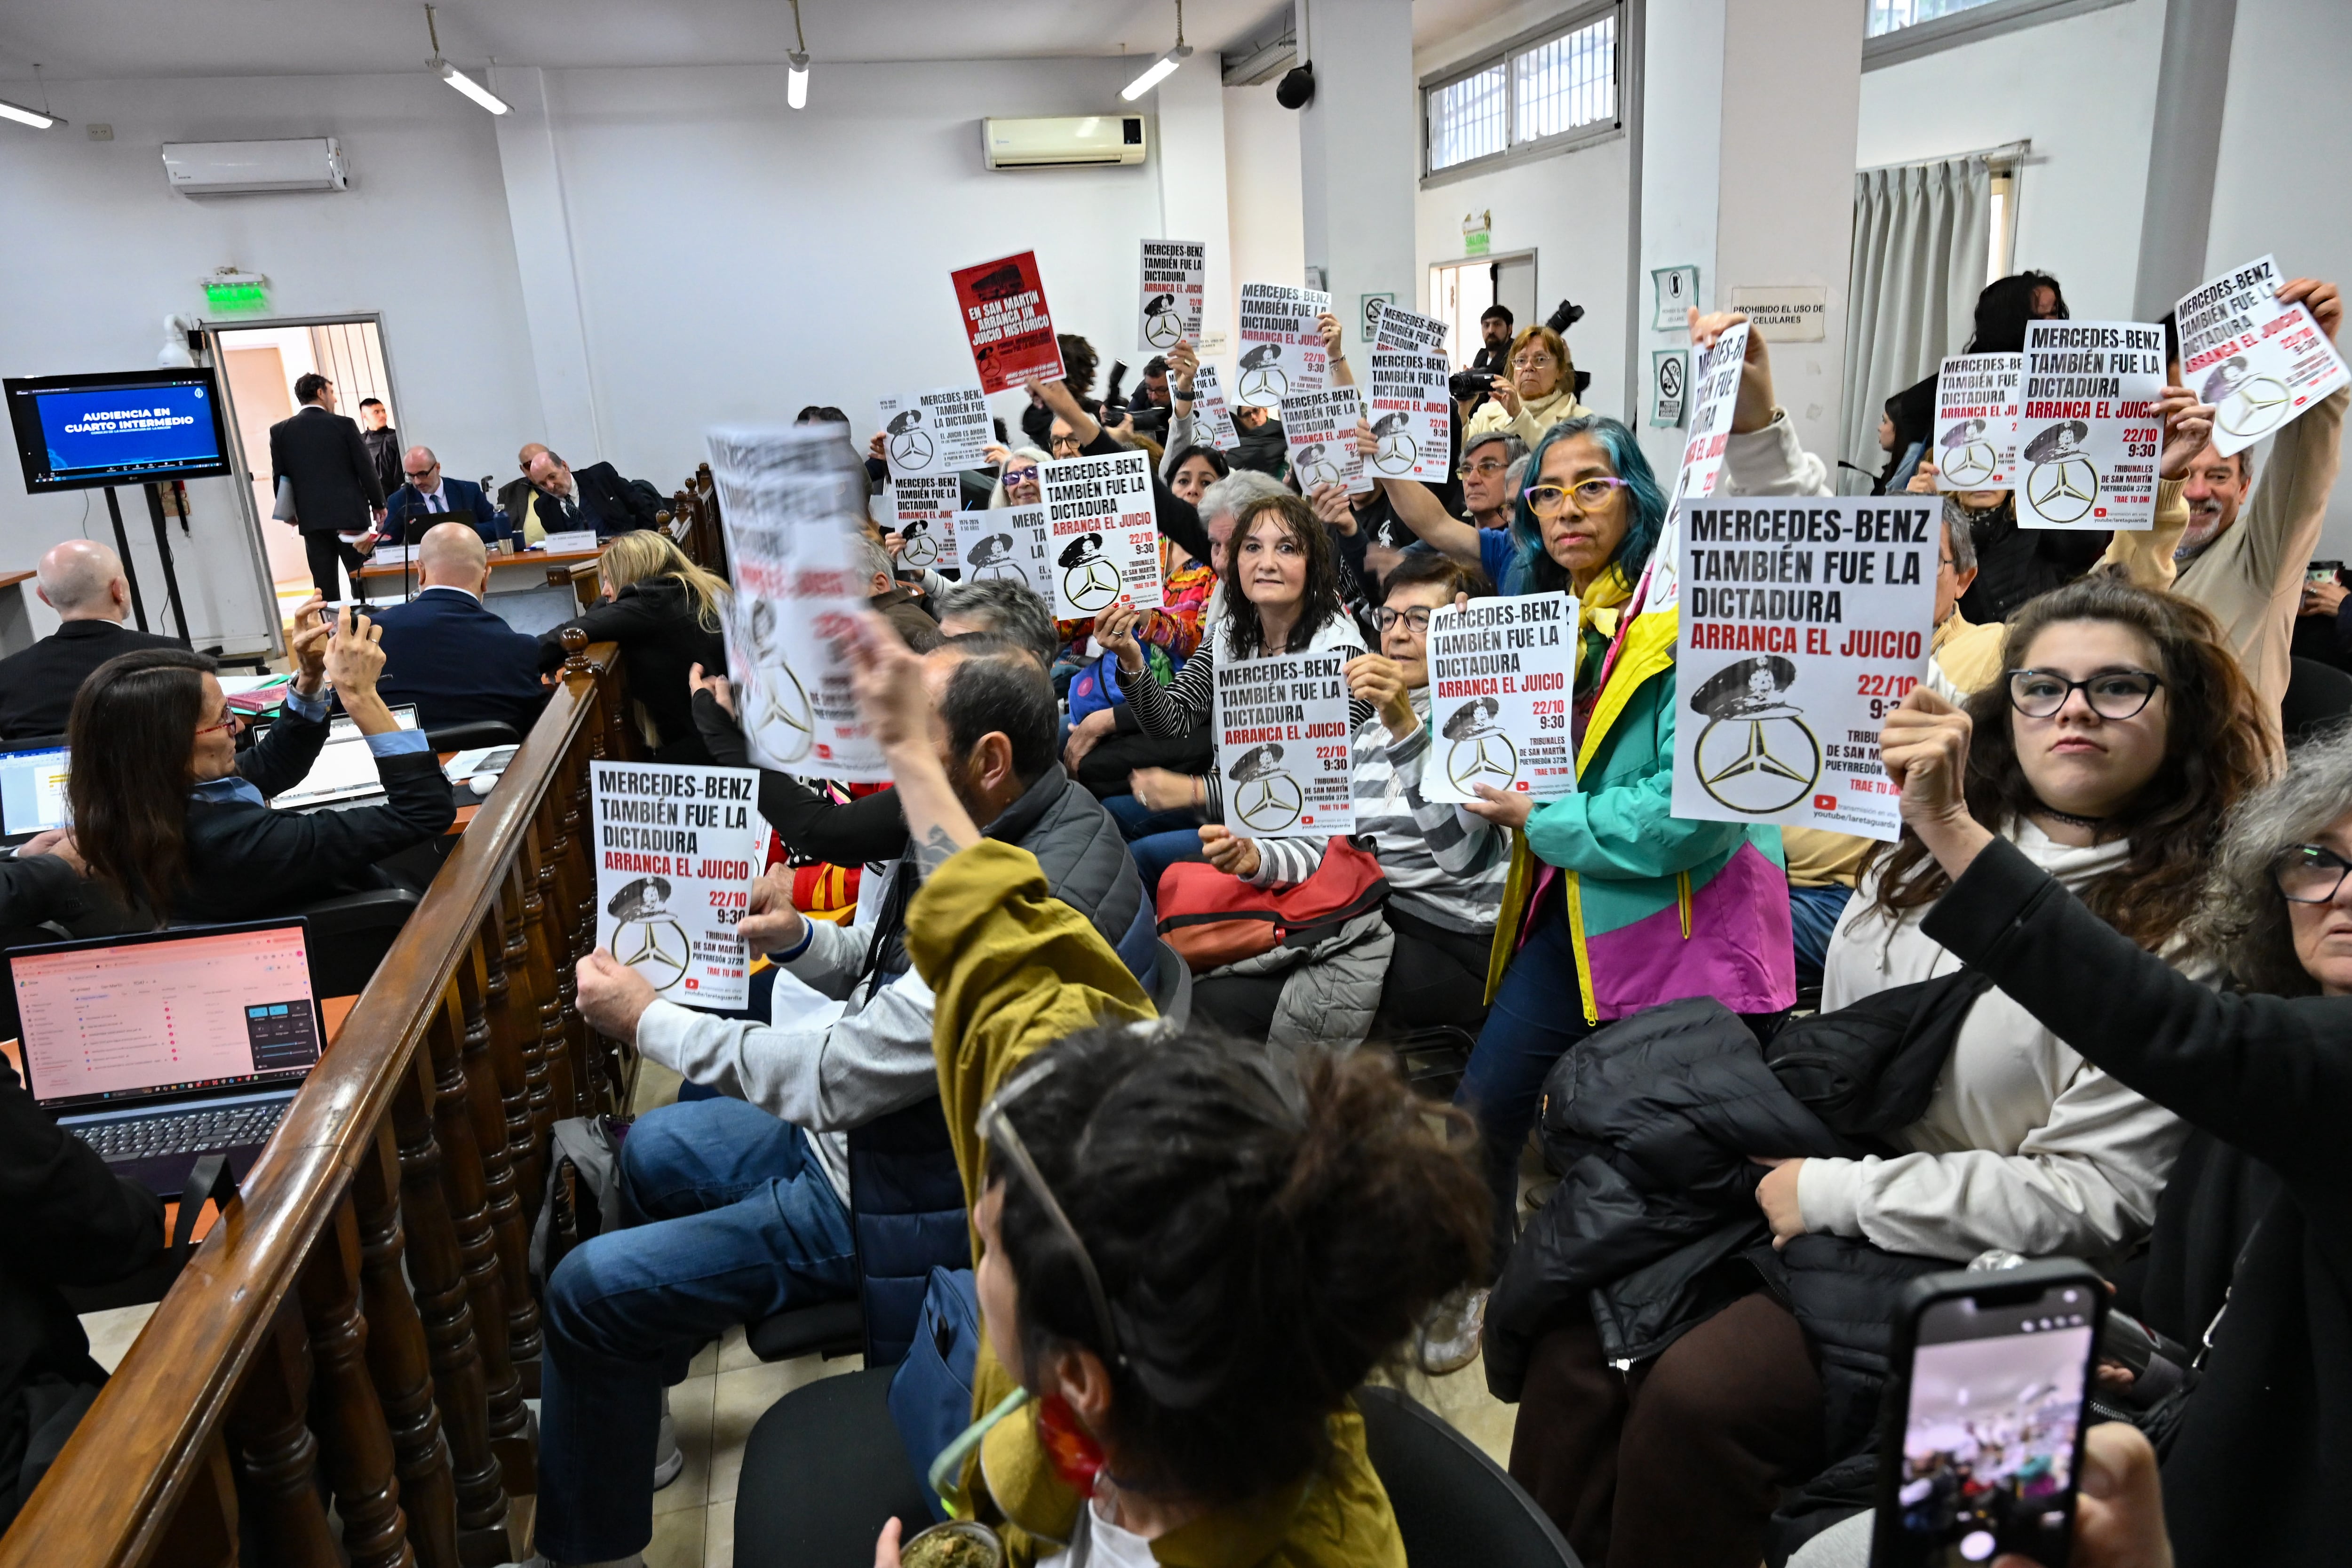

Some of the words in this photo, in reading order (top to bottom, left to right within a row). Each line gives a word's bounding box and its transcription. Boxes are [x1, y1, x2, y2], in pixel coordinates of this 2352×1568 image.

[1144, 244, 1202, 257] MERCEDES-BENZ
[1144, 256, 1177, 270] TAMBIÉN
[1180, 260, 1192, 270] FUE
[1194, 260, 1201, 271] LA
[1145, 271, 1185, 282] DICTADURA
[1144, 283, 1174, 293] ARRANCA
[1177, 284, 1183, 293] EL
[1185, 284, 1202, 294] JUICIO
[1242, 284, 1329, 304] MERCEDES-BENZ
[2179, 262, 2273, 321] MERCEDES-BENZ
[968, 307, 982, 320] EN
[983, 300, 1002, 317] SAN
[1004, 290, 1039, 311] MARTÍN
[1242, 299, 1288, 316] TAMBIÉN
[1292, 304, 1310, 317] FUE
[977, 311, 1020, 332] ARRANCA
[1022, 306, 1035, 319] UN
[1242, 316, 1299, 332] DICTADURA
[1384, 308, 1447, 337] MERCEDES-BENZ
[2181, 302, 2228, 340] TAMBIÉN
[972, 328, 1002, 346] JUICIO
[1242, 330, 1282, 343] ARRANCA
[1286, 334, 1295, 344] EL
[1382, 320, 1414, 341] TAMBIÉN
[1415, 331, 1430, 344] FUE
[2032, 328, 2160, 350] MERCEDES-BENZ
[2183, 315, 2255, 358] DICTADURA
[1379, 331, 1419, 351] DICTADURA
[1304, 352, 1325, 363] 22/10
[1372, 355, 1446, 372] MERCEDES-BENZ
[2030, 349, 2104, 374] TAMBIÉN
[2110, 354, 2137, 374] FUE
[2143, 355, 2160, 374] LA
[1308, 363, 1324, 373] 9:30
[1373, 369, 1415, 383] TAMBIÉN
[1418, 372, 1433, 385] FUE
[1436, 375, 1446, 387] LA
[1943, 371, 1993, 390] TAMBIÉN
[1998, 374, 2018, 387] FUE
[1373, 385, 1424, 399] DICTADURA
[2028, 377, 2120, 398] DICTADURA
[921, 390, 982, 406] MERCEDES-BENZ
[1281, 389, 1355, 410] MERCEDES-BENZ
[1942, 390, 2005, 405] DICTADURA
[83, 409, 151, 422] AUDIENCIA
[154, 408, 170, 416] EN
[936, 400, 968, 417] TAMBIÉN
[971, 401, 985, 412] FUE
[1284, 406, 1323, 422] TAMBIÉN
[1326, 406, 1342, 417] FUE
[1344, 403, 1356, 414] LA
[1372, 399, 1410, 411] ARRANCA
[1413, 400, 1421, 412] EL
[1424, 402, 1447, 414] JUICIO
[1941, 406, 1986, 419] ARRANCA
[1990, 406, 2001, 417] EL
[2025, 402, 2090, 419] ARRANCA
[2096, 402, 2110, 418] EL
[65, 422, 116, 433] CUARTO
[119, 416, 194, 429] INTERMEDIO
[934, 418, 944, 429] LA
[946, 413, 988, 427] DICTADURA
[1287, 419, 1335, 435] DICTADURA
[1430, 419, 1447, 429] 22/10
[1433, 429, 1447, 438] 9:30
[2123, 429, 2157, 442] 22/10
[2128, 444, 2156, 457] 9:30
[1045, 458, 1144, 484] MERCEDES-BENZ
[2126, 473, 2152, 483] MARTÍN
[895, 478, 957, 489] MERCEDES-BENZ
[1047, 479, 1102, 502] TAMBIÉN
[1106, 478, 1128, 495] FUE
[1131, 477, 1145, 493] LA
[896, 488, 929, 500] TAMBIÉN
[931, 489, 944, 499] FUE
[947, 489, 956, 498] LA
[898, 500, 938, 510] DICTADURA
[1050, 498, 1118, 520] DICTADURA
[1053, 517, 1101, 536] ARRANCA
[1104, 517, 1116, 530] EL
[1120, 511, 1151, 528] JUICIO
[1690, 509, 1931, 542] MERCEDES-BENZ
[1129, 532, 1153, 544] 22/10
[1136, 543, 1154, 555] 9:30
[1690, 543, 1813, 583] TAMBIÉN
[1824, 551, 1875, 584] FUE
[1885, 551, 1921, 585] LA
[1692, 587, 1842, 623] DICTADURA
[1434, 600, 1560, 632] MERCEDES-BENZ
[1433, 628, 1502, 656] TAMBIÉN
[1507, 627, 1534, 649] FUE
[1541, 625, 1559, 646] LA
[1690, 623, 1797, 653] ARRANCA
[1806, 628, 1832, 655] EL
[1841, 630, 1922, 660] JUICIO
[1219, 659, 1341, 687] MERCEDES-BENZ
[1436, 653, 1521, 679] DICTADURA
[1438, 677, 1498, 699] ARRANCA
[1503, 676, 1517, 693] EL
[1522, 672, 1564, 692] JUICIO
[1221, 681, 1286, 708] TAMBIÉN
[1291, 682, 1318, 701] FUE
[1323, 681, 1341, 699] LA
[1533, 700, 1565, 715] 22/10
[1223, 705, 1304, 728] DICTADURA
[1540, 715, 1565, 730] 9:30
[1225, 726, 1283, 745] ARRANCA
[1287, 725, 1301, 740] EL
[1305, 722, 1346, 739] JUICIO
[1317, 745, 1347, 759] 22/10
[1827, 744, 1840, 756] DE
[1843, 745, 1865, 759] SAN
[1324, 759, 1348, 771] 9:30
[1825, 759, 1883, 775] PUEYRREDÓN
[599, 770, 753, 800] MERCEDES-BENZ
[1850, 779, 1873, 792] TRAE
[1877, 782, 1888, 794] TU
[600, 796, 678, 826] TAMBIÉN
[685, 805, 718, 828] FUE
[725, 805, 747, 829] LA
[1813, 811, 1896, 828] youtube/laretaguardia
[603, 825, 698, 854] DICTADURA
[604, 851, 671, 876] ARRANCA
[676, 858, 692, 878] EL
[697, 860, 748, 880] JUICIO
[709, 891, 747, 908] 22/10
